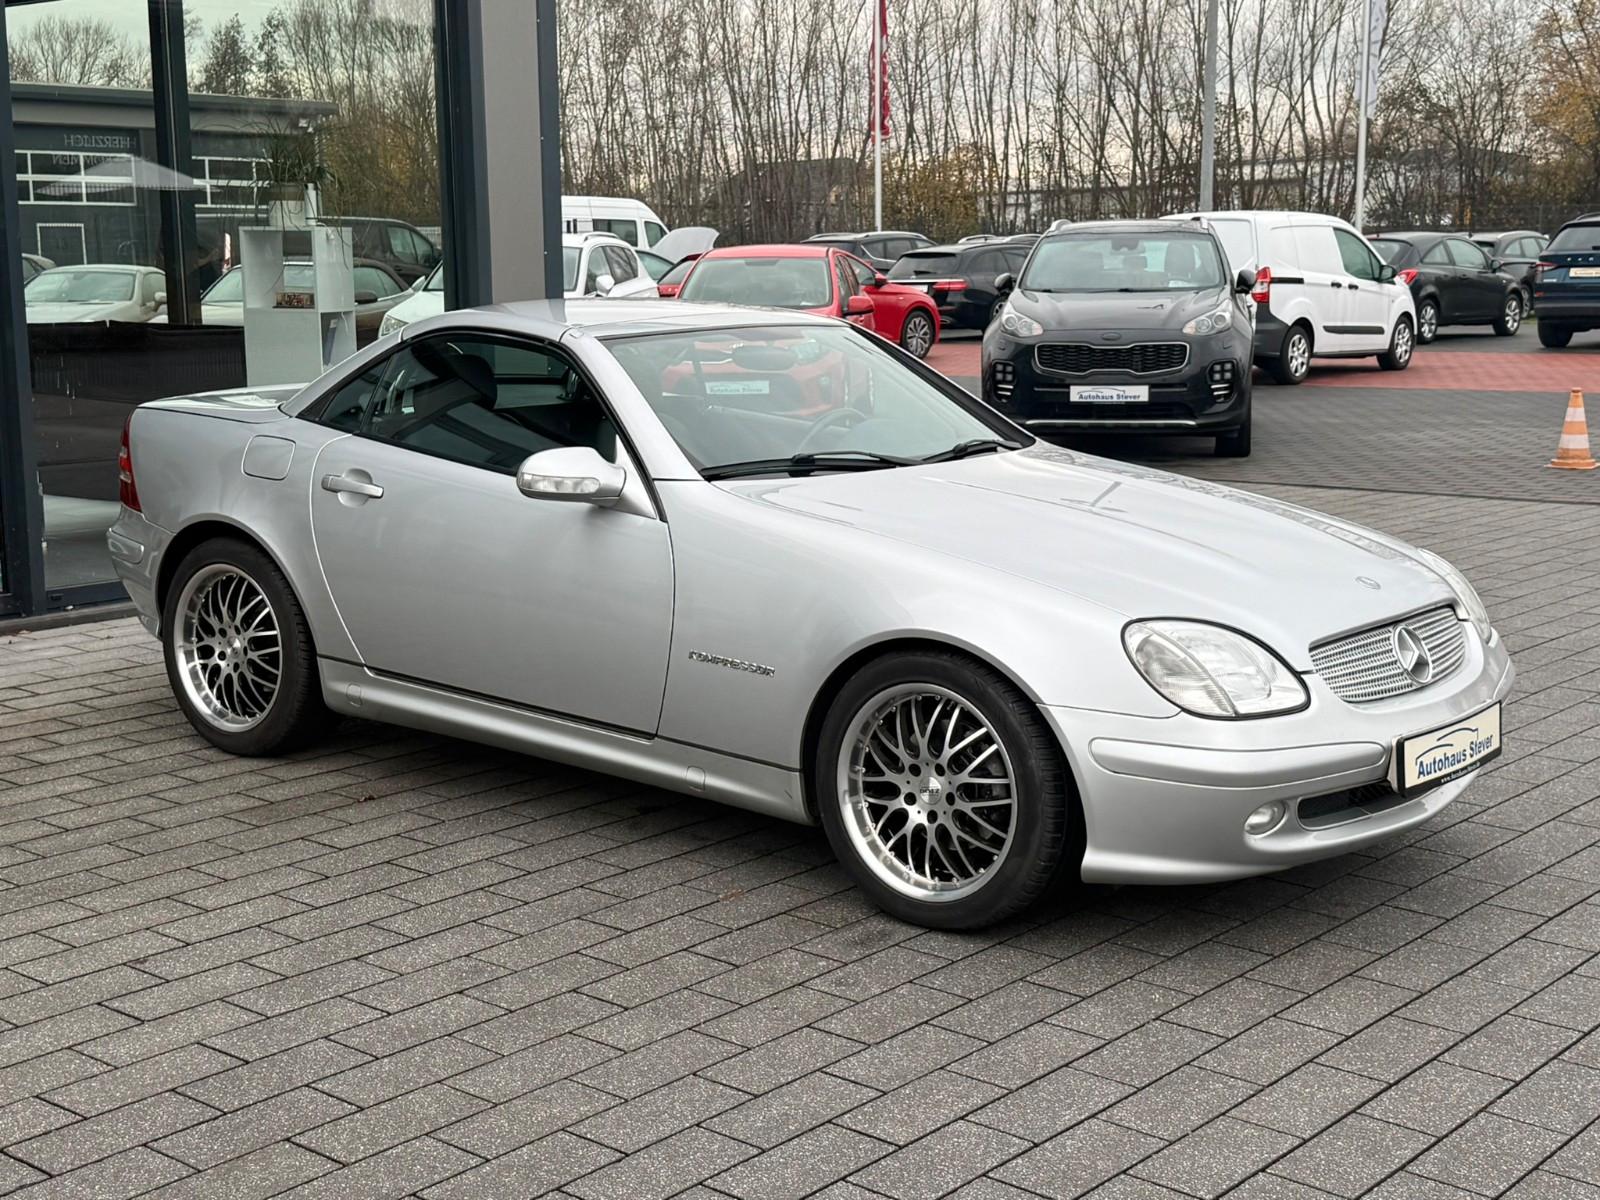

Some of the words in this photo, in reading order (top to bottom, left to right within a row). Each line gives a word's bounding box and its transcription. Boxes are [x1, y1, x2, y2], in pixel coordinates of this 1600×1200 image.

[689, 649, 775, 677] KOMPRESSOR
[1417, 749, 1467, 779] Autohaus
[1469, 734, 1494, 758] Stever
